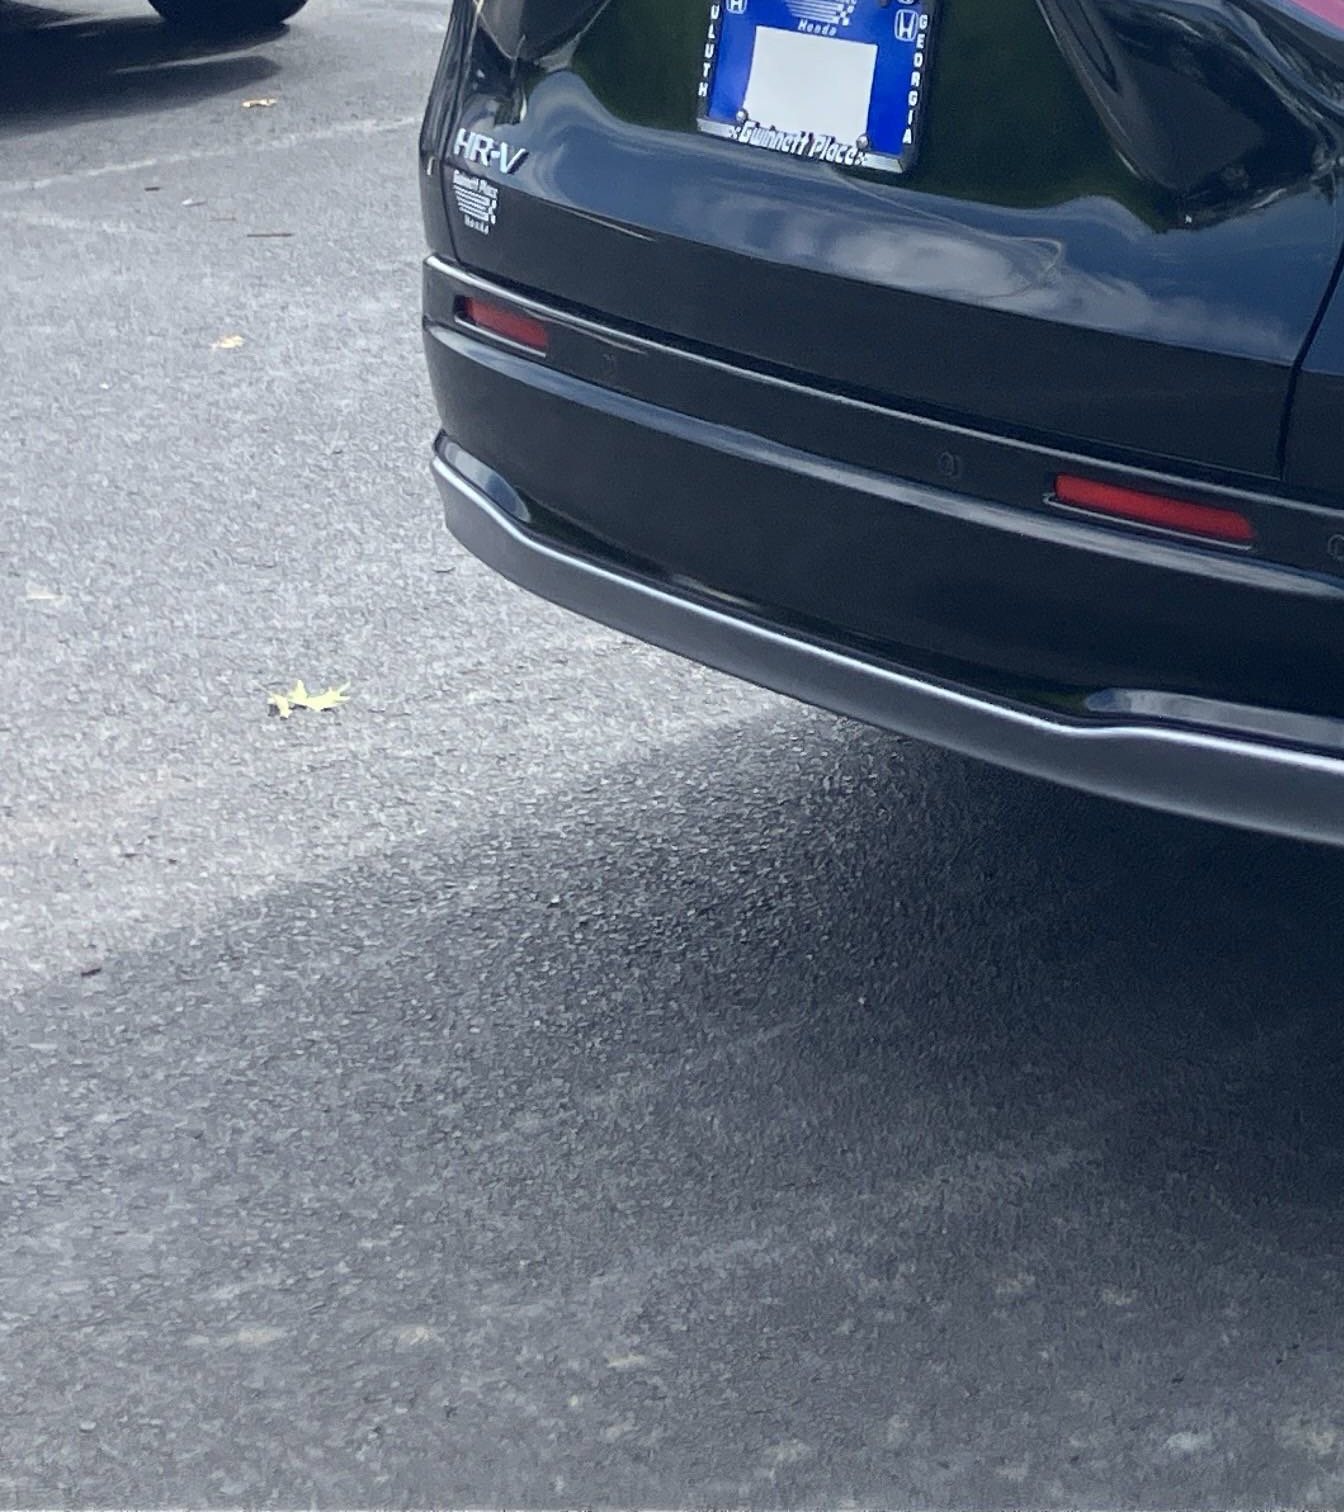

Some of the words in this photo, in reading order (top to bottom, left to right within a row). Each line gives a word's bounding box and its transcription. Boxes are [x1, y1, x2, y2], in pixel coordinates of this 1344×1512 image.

[798, 19, 838, 36] Honda
[902, 14, 929, 145] GEORGIA
[453, 127, 529, 174] HR-V
[739, 119, 809, 156] Gwinnett
[807, 134, 859, 166] Place
